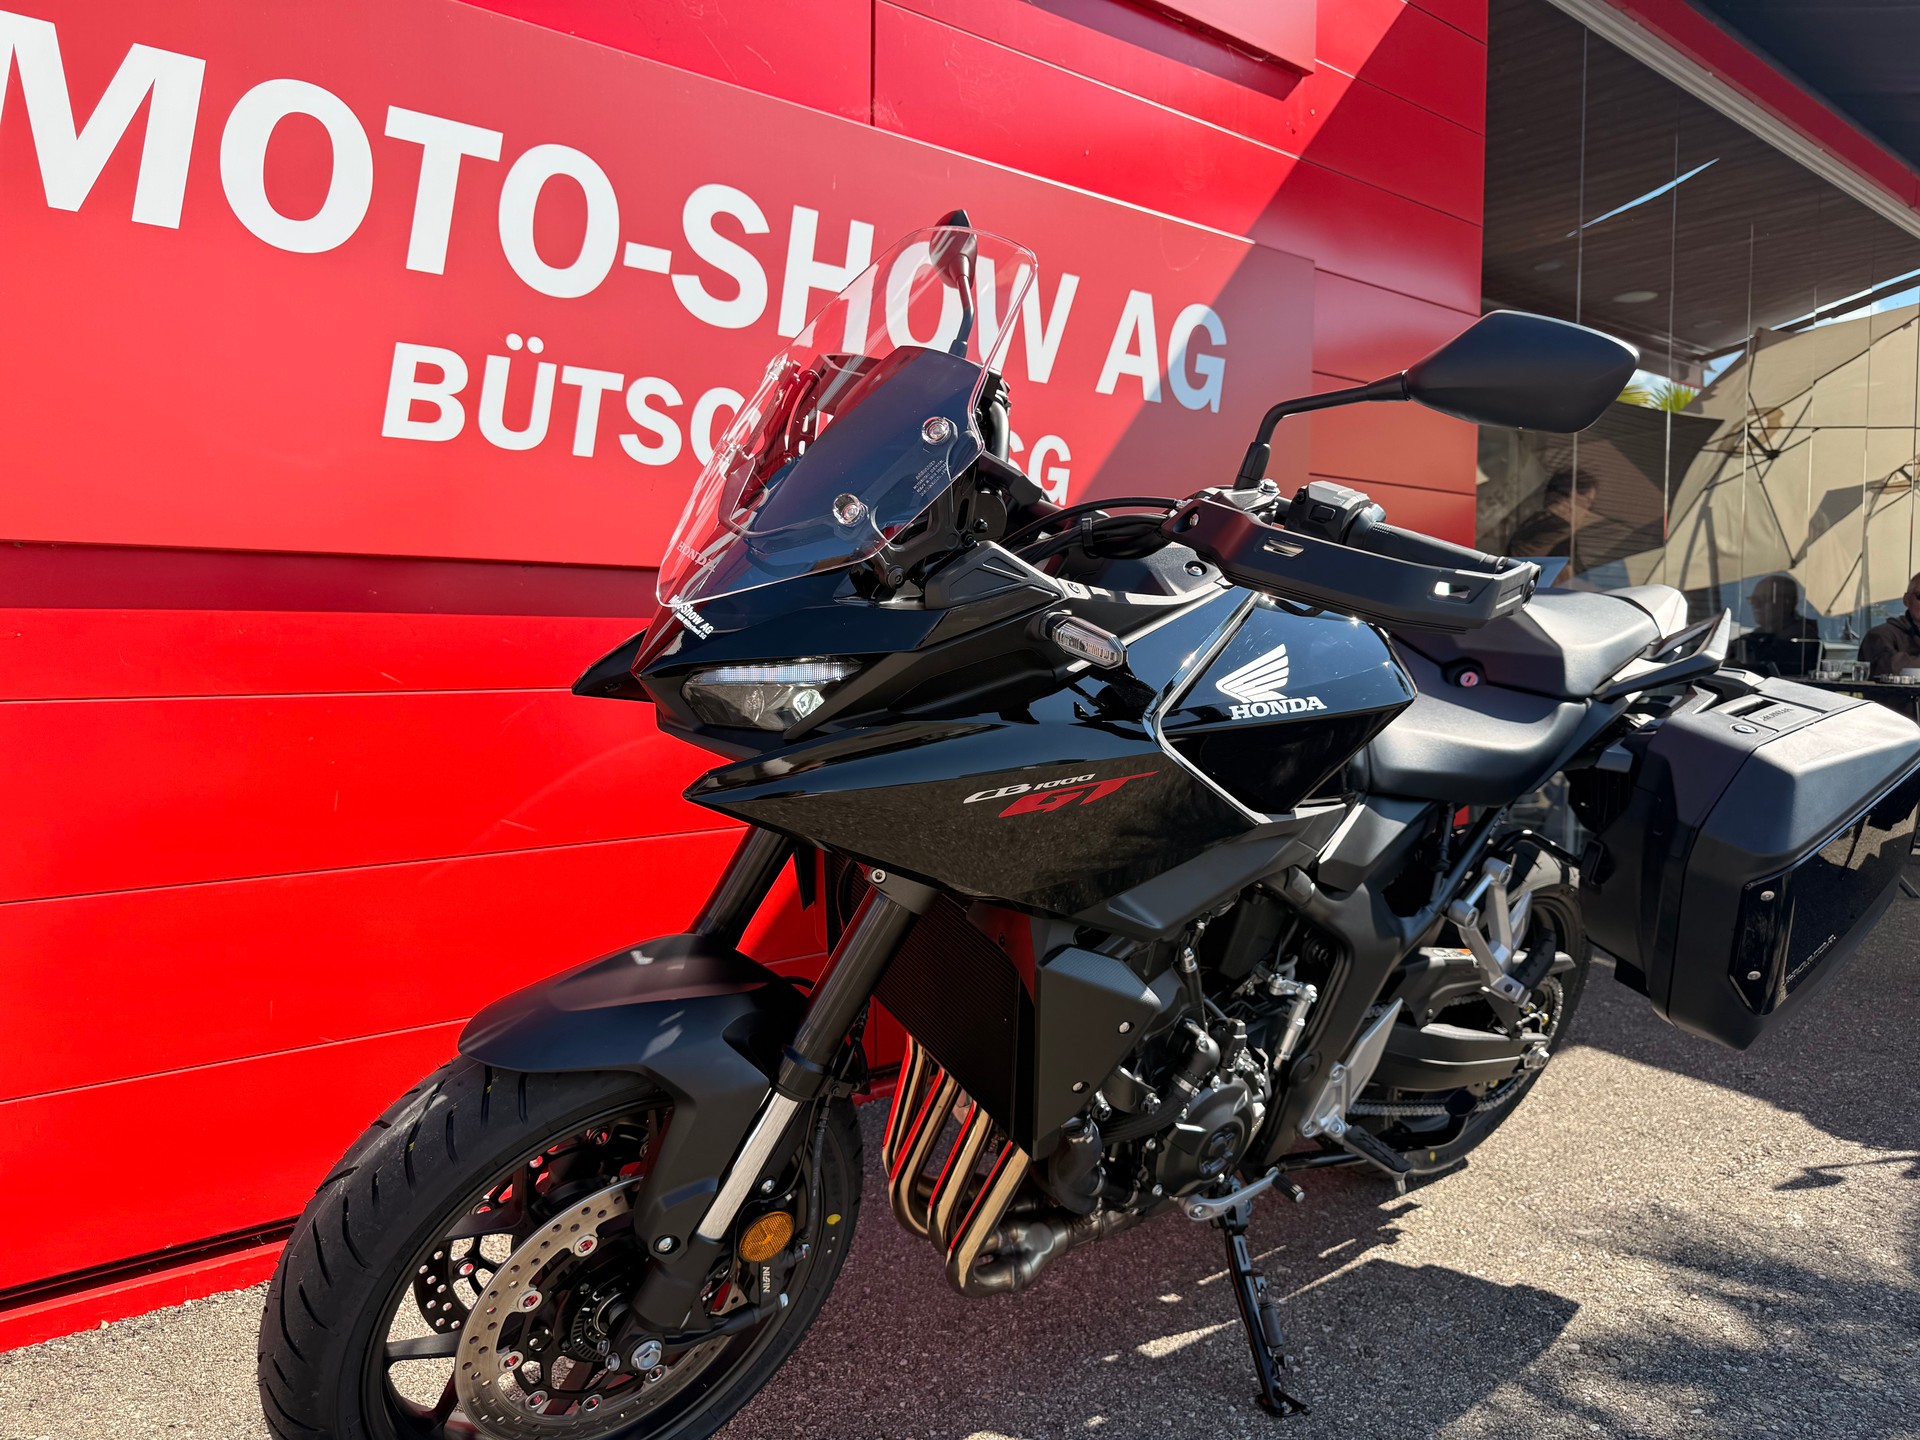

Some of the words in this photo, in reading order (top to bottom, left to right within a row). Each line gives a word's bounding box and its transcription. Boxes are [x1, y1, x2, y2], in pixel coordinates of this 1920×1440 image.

[0, 9, 1080, 384] MOTO-SHOW
[1095, 289, 1227, 413] AG
[381, 333, 765, 470] BÜTSC
[1228, 696, 1327, 720] HONDA
[998, 770, 1160, 818] GT
